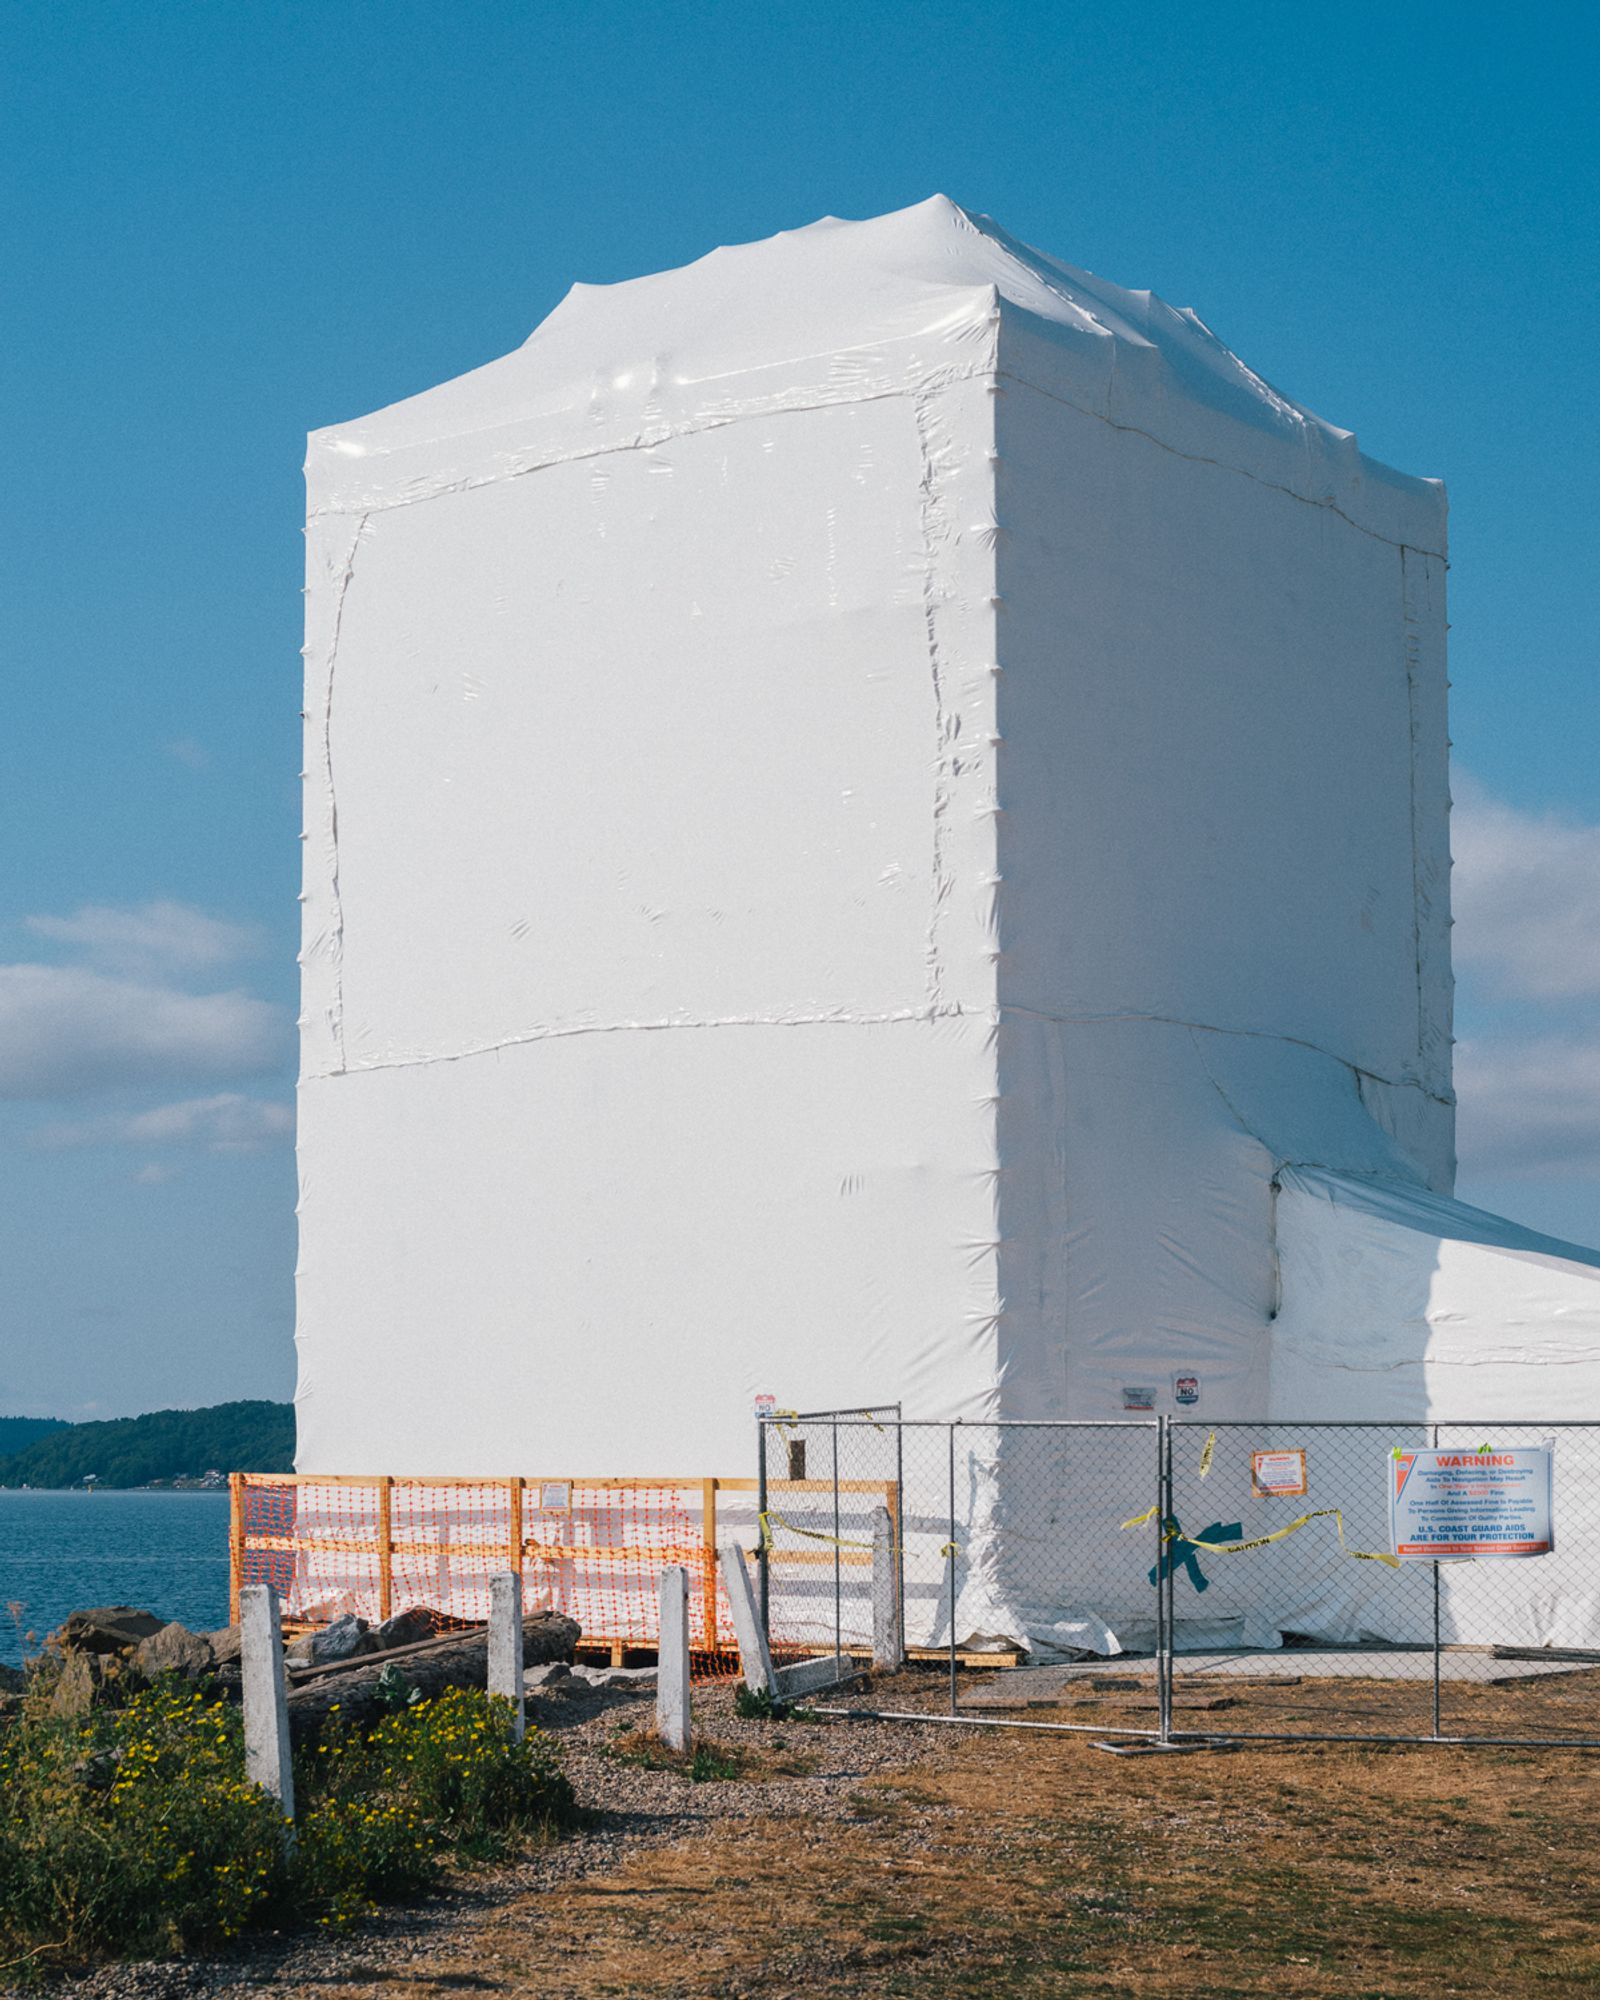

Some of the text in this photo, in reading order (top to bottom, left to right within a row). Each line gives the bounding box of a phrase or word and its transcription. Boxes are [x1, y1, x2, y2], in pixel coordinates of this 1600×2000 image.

[1181, 1387, 1194, 1395] NO
[1435, 1454, 1515, 1467] WARNING
[1505, 1523, 1526, 1531] AIDS
[1452, 1533, 1476, 1541] YOUR
[1478, 1532, 1535, 1540] PROTECTION
